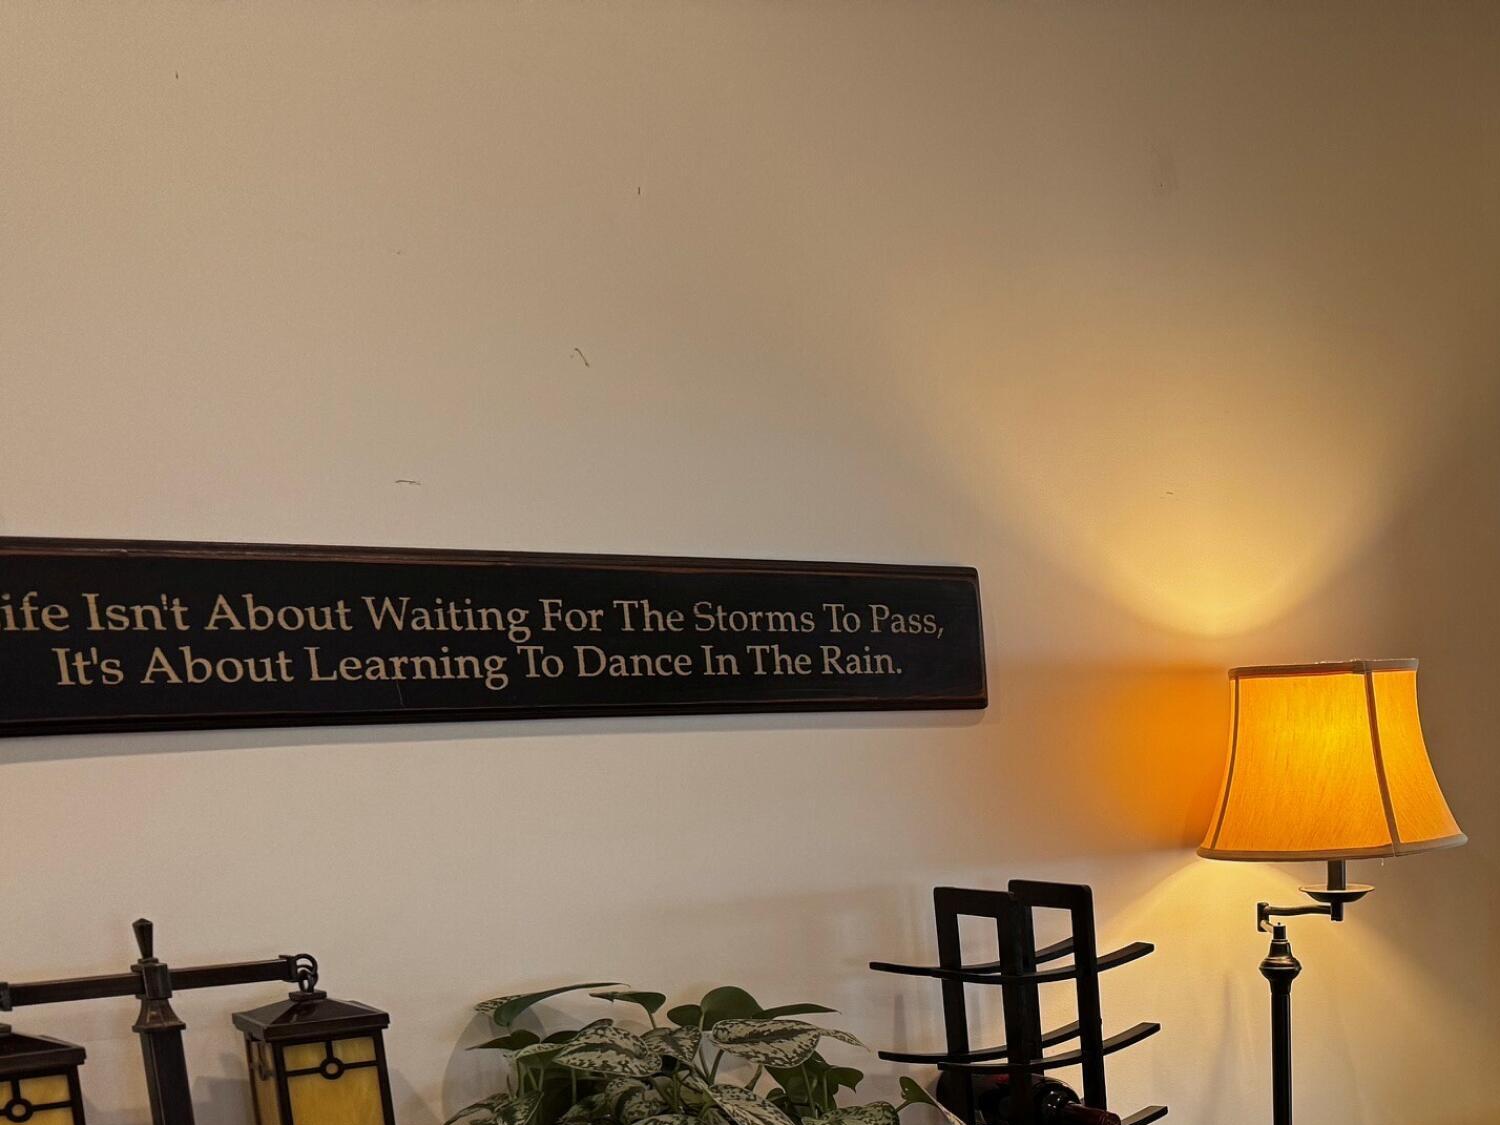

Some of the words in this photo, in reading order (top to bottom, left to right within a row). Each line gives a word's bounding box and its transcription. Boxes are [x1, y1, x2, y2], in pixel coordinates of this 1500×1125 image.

[0, 591, 70, 632] ife
[82, 592, 191, 631] Isn't
[204, 593, 352, 631] About
[361, 596, 532, 643] Waiting
[538, 599, 604, 631] For
[613, 600, 685, 632] The
[693, 601, 816, 633] Storms
[822, 603, 861, 633] To
[868, 604, 944, 640] Pass,
[52, 646, 124, 686] It's
[140, 645, 294, 685] About
[303, 646, 509, 690] Learning
[516, 645, 564, 678] To
[573, 645, 692, 677] Dance
[700, 645, 740, 676] In
[746, 645, 812, 676] The
[820, 645, 902, 675] Rain.
